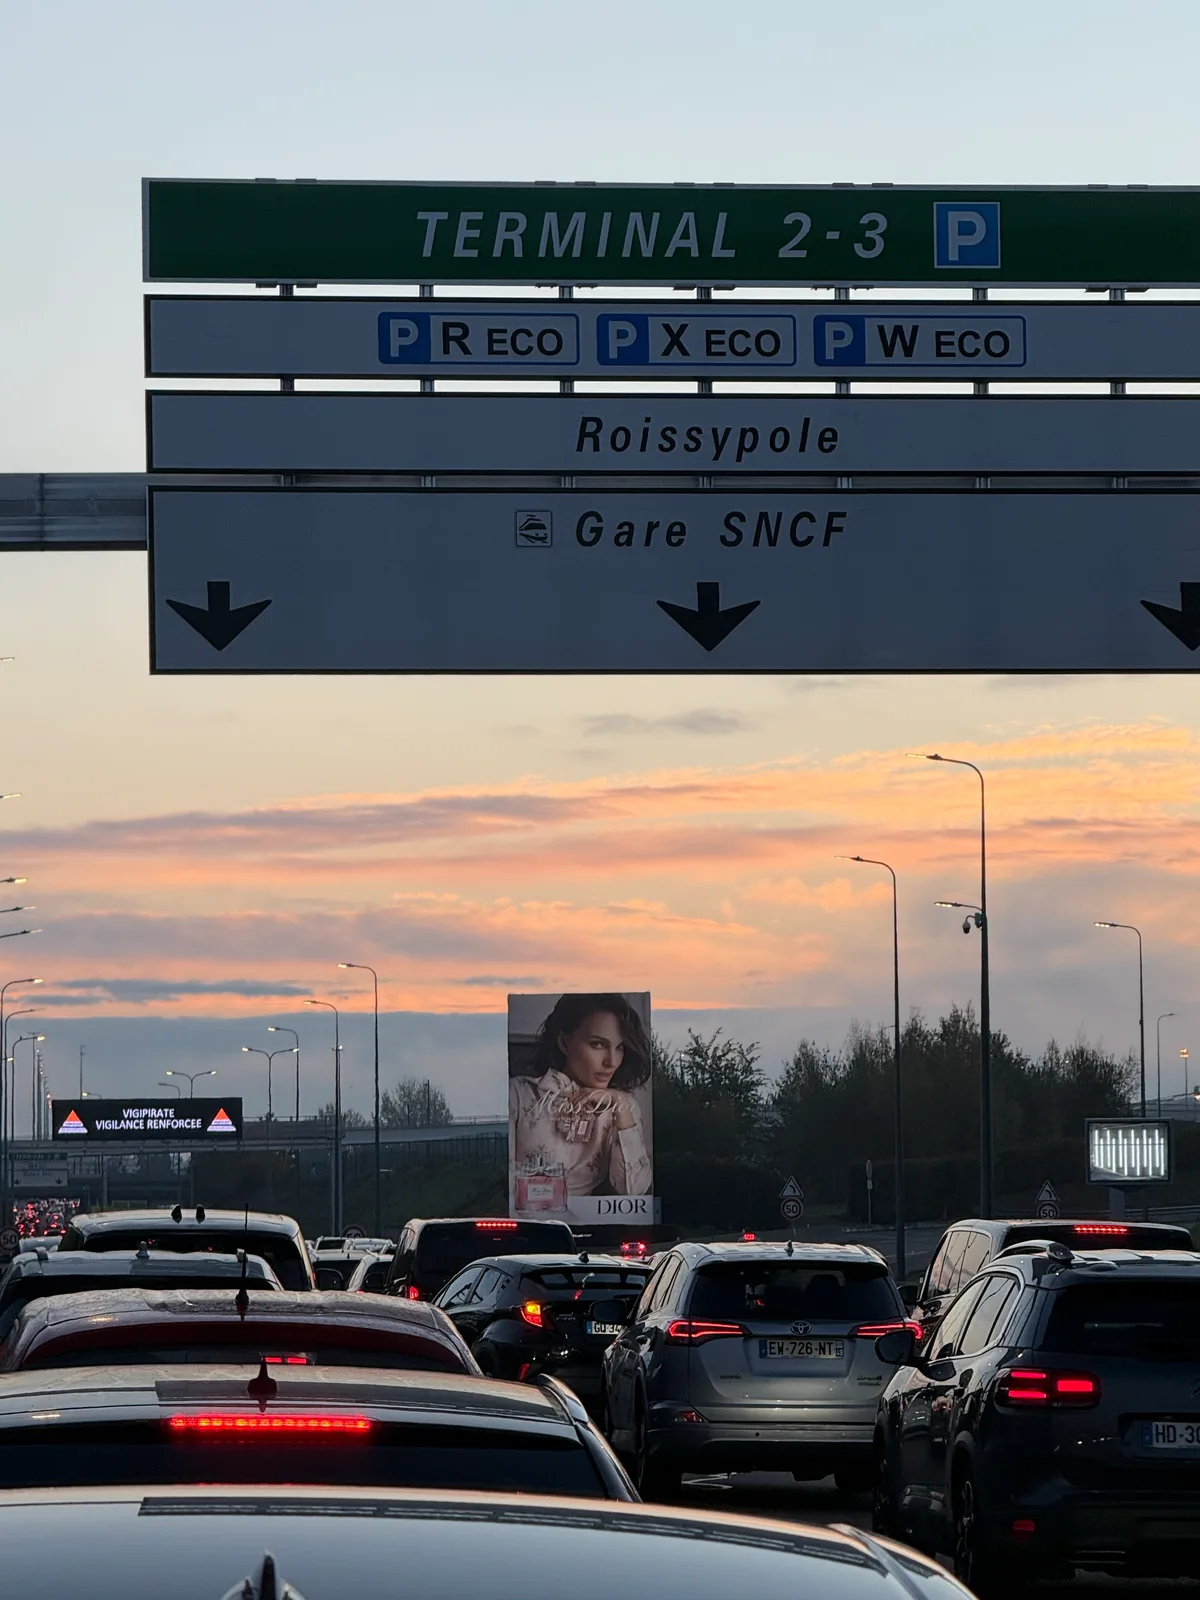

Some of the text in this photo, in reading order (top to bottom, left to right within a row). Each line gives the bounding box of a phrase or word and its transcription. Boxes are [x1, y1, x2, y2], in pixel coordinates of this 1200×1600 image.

[416, 211, 737, 258] TERMINAL
[947, 210, 988, 261] P
[389, 318, 564, 358] P R ECO
[608, 320, 782, 359] P X ECO
[824, 321, 1011, 360] P W ECO
[575, 416, 839, 462] Roissypole
[575, 510, 847, 547] Gare SNCF
[526, 1089, 582, 1114] Miss
[122, 1108, 175, 1118] VIGIPIRATE
[95, 1118, 202, 1130] VIGILANCE RENFORCEE
[597, 1198, 649, 1215] DIOR
[786, 1204, 798, 1214] 50
[1042, 1208, 1055, 1218] 50
[3, 1234, 17, 1245] 50
[769, 1341, 834, 1356] EW-726-NT
